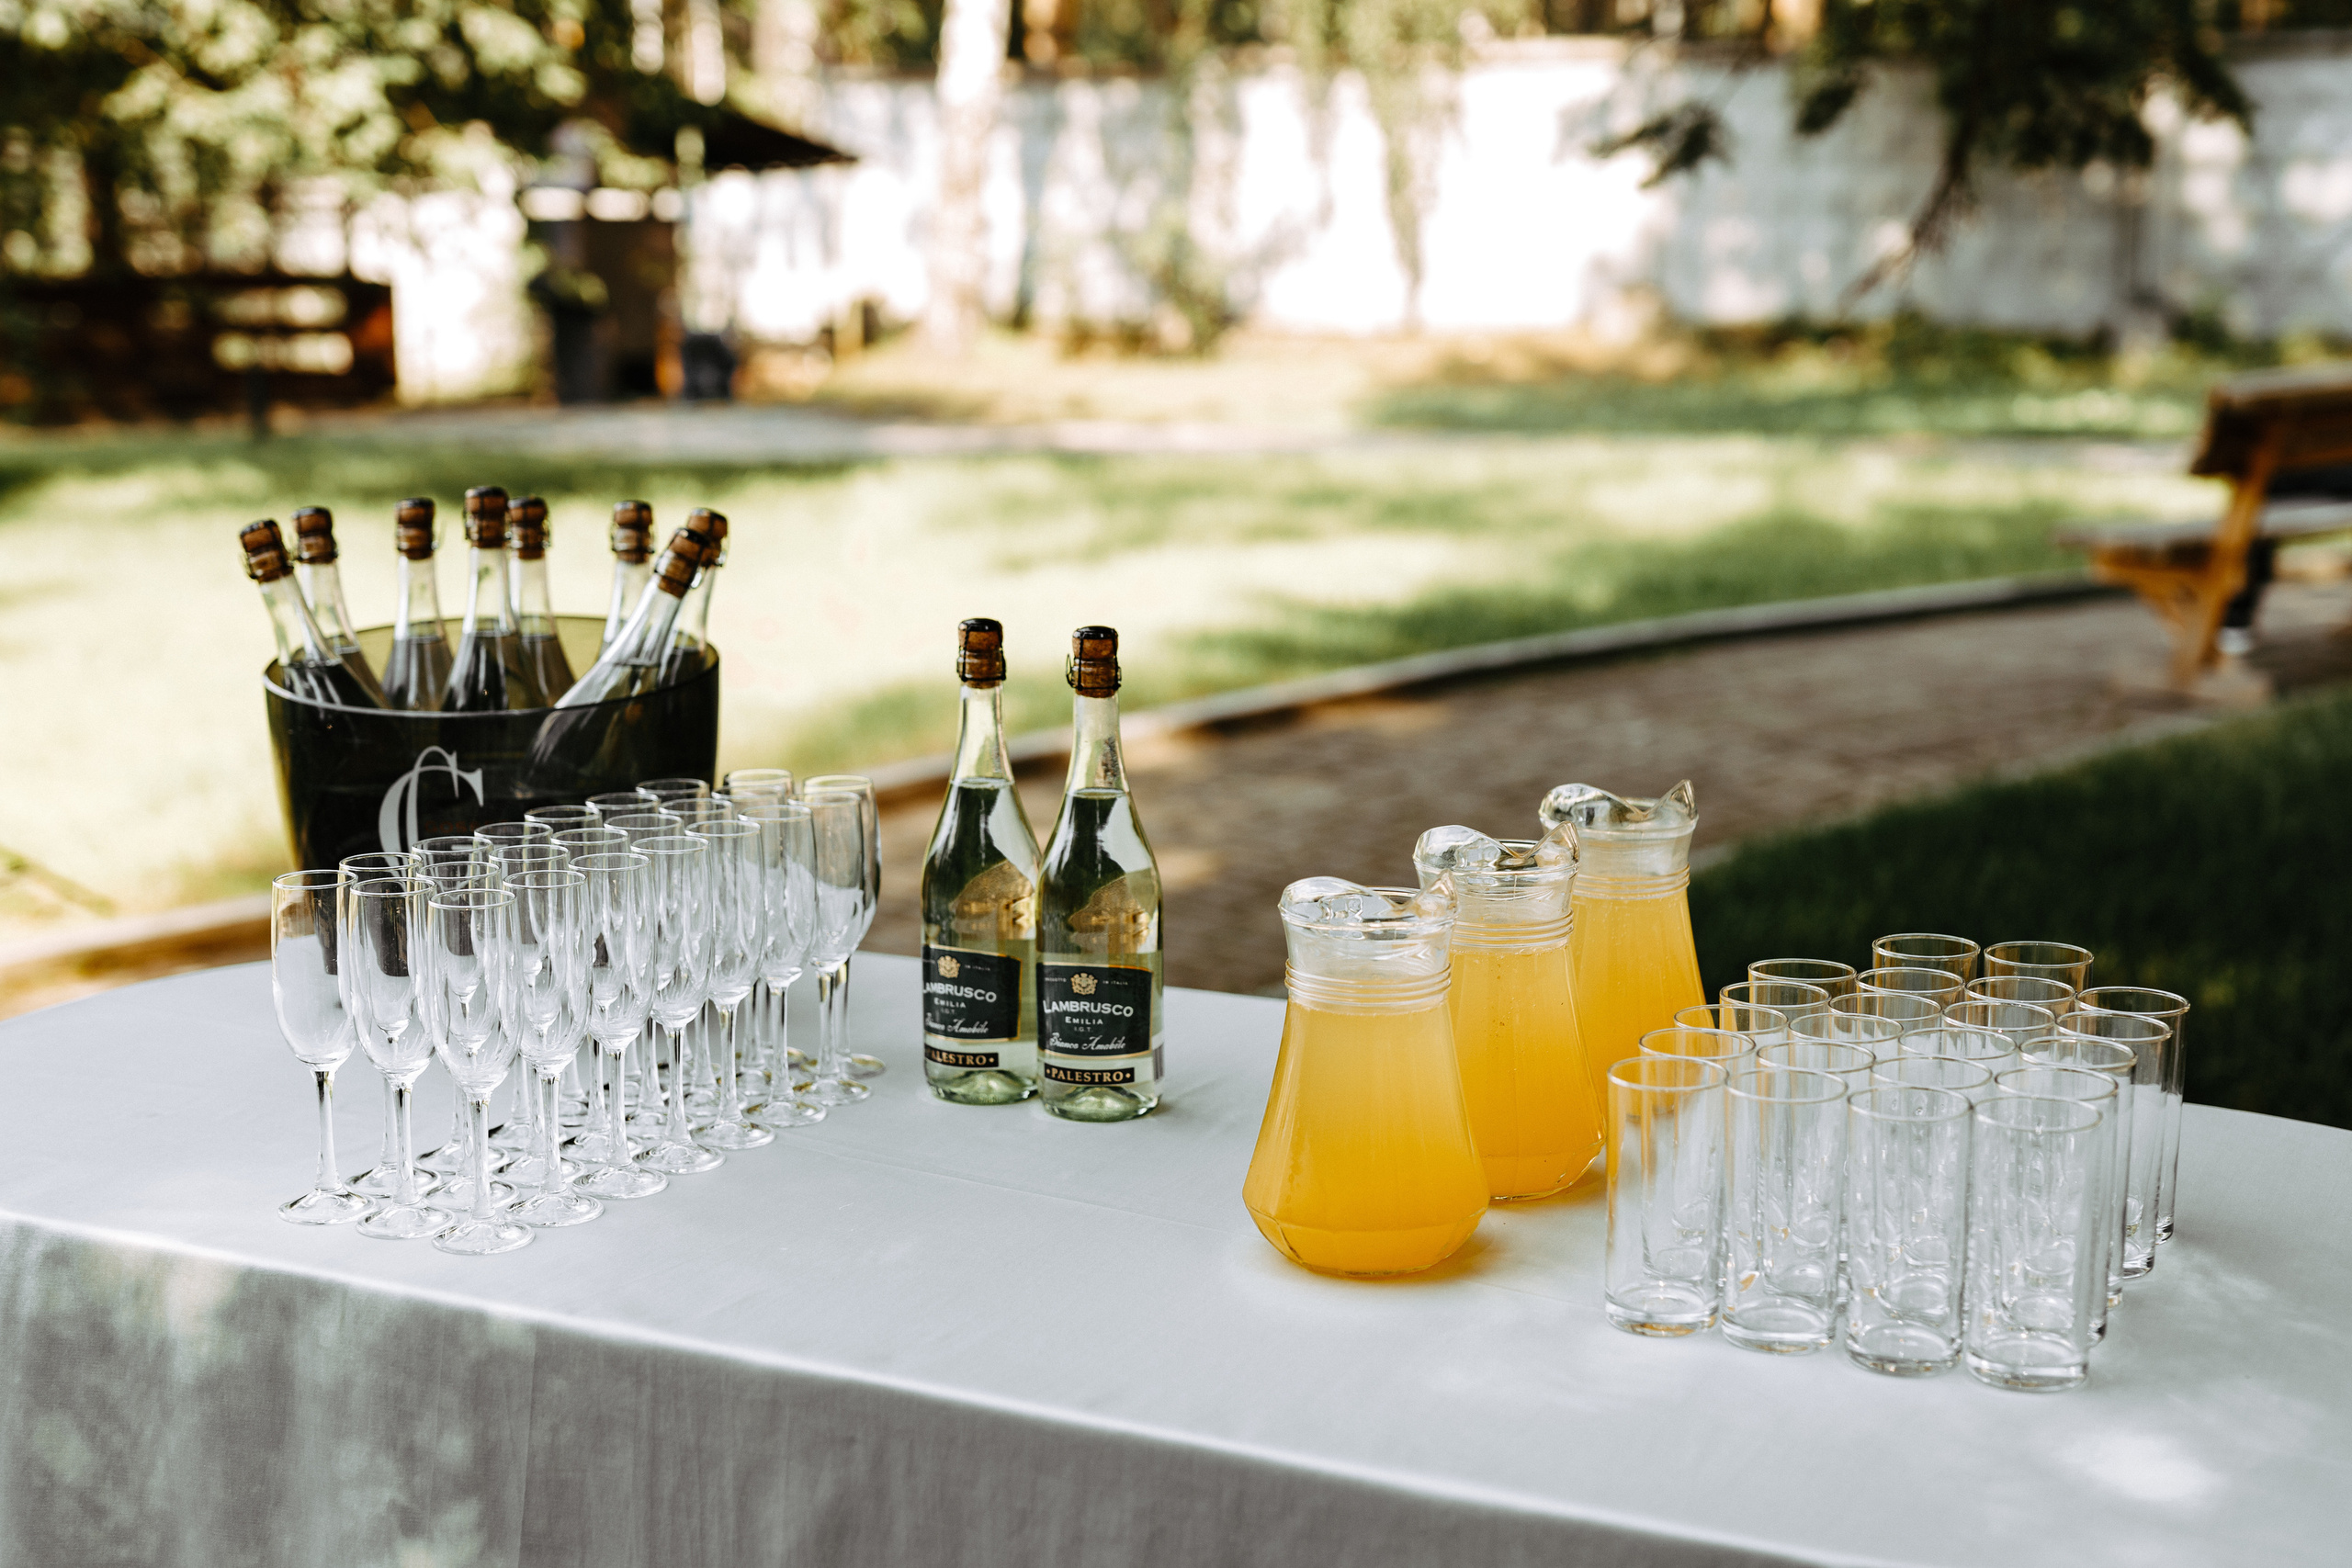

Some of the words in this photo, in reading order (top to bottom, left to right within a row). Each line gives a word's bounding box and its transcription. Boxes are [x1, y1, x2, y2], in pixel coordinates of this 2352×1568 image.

[933, 998, 967, 1009] EMILIA
[1043, 1000, 1134, 1018] LAMBRUSCO
[1065, 1016, 1103, 1025] EMILIA
[1049, 1032, 1079, 1050] Bianco
[1081, 1034, 1126, 1051] Amabile
[927, 1049, 987, 1066] ALESTRO
[1051, 1067, 1124, 1082] PALESTRO
